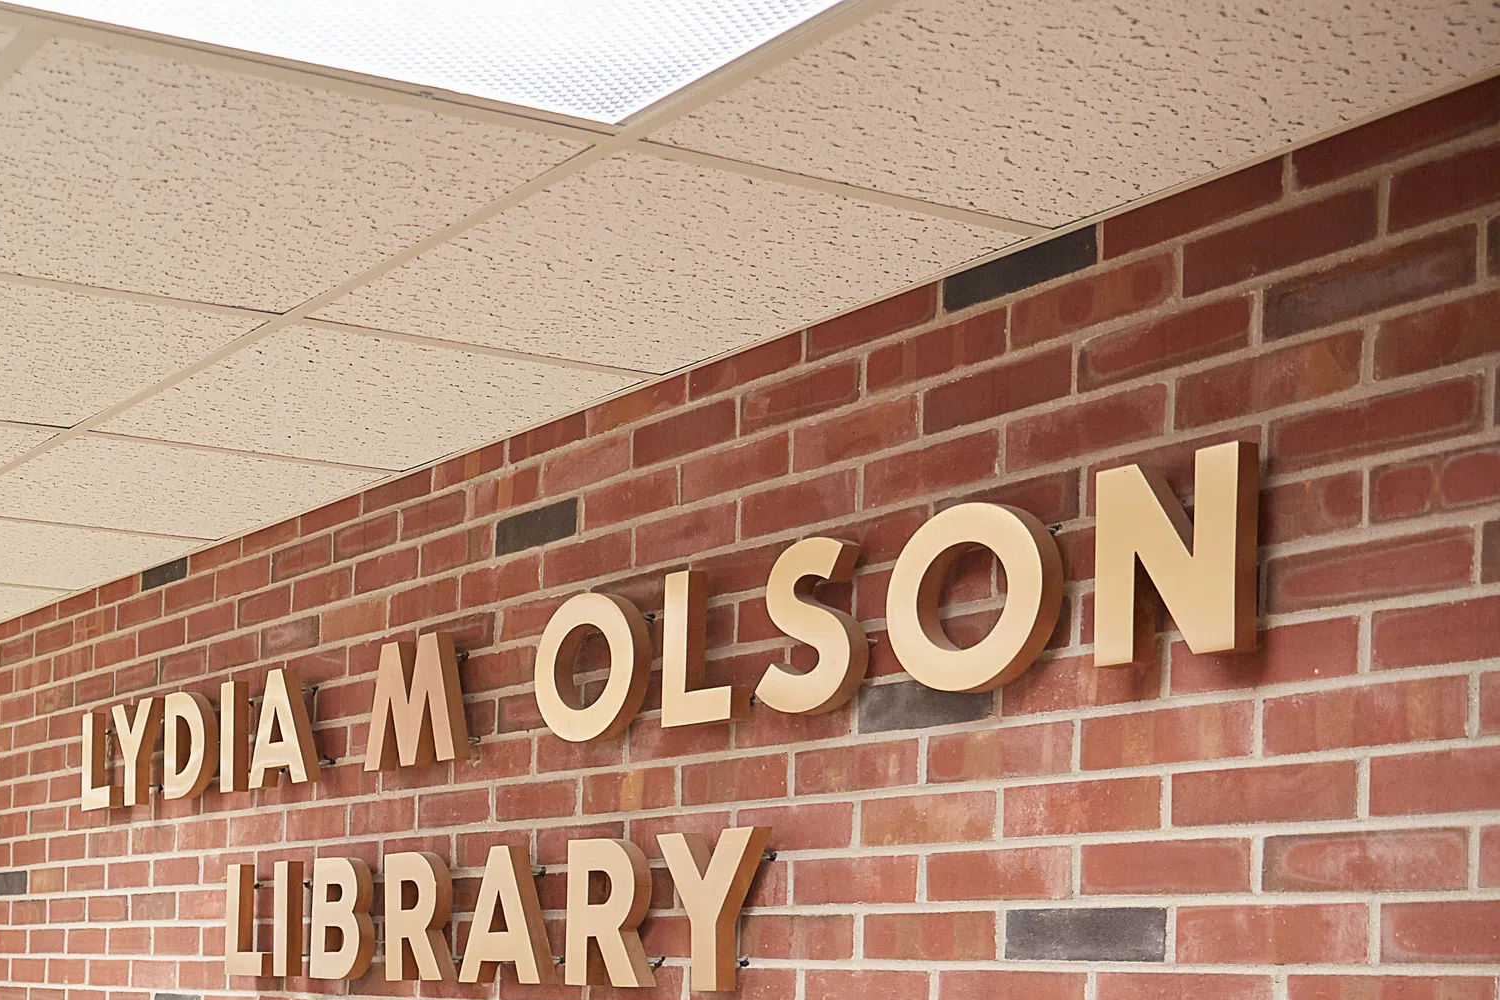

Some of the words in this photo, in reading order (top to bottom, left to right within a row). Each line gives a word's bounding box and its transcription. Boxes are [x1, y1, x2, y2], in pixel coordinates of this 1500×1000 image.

[81, 668, 318, 811] LYDIA
[364, 632, 470, 772] M
[534, 440, 1258, 742] OLSON
[225, 826, 773, 992] LIBRARY
